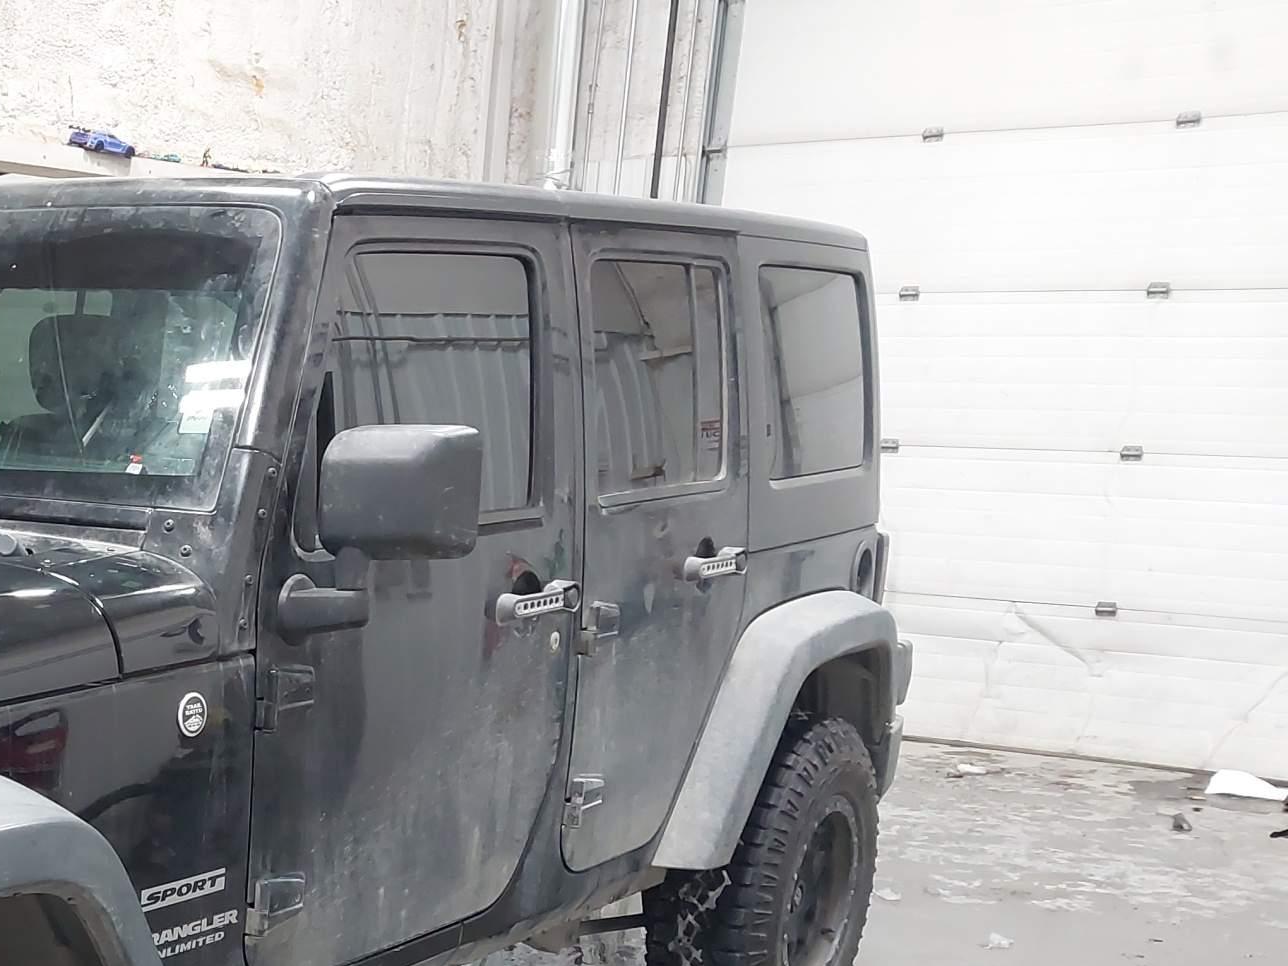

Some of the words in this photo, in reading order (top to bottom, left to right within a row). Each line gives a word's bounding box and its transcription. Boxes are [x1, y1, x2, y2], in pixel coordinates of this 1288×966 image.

[145, 875, 223, 906] SPORT
[152, 909, 239, 946] RANGLER
[158, 931, 225, 959] NLIMITED
